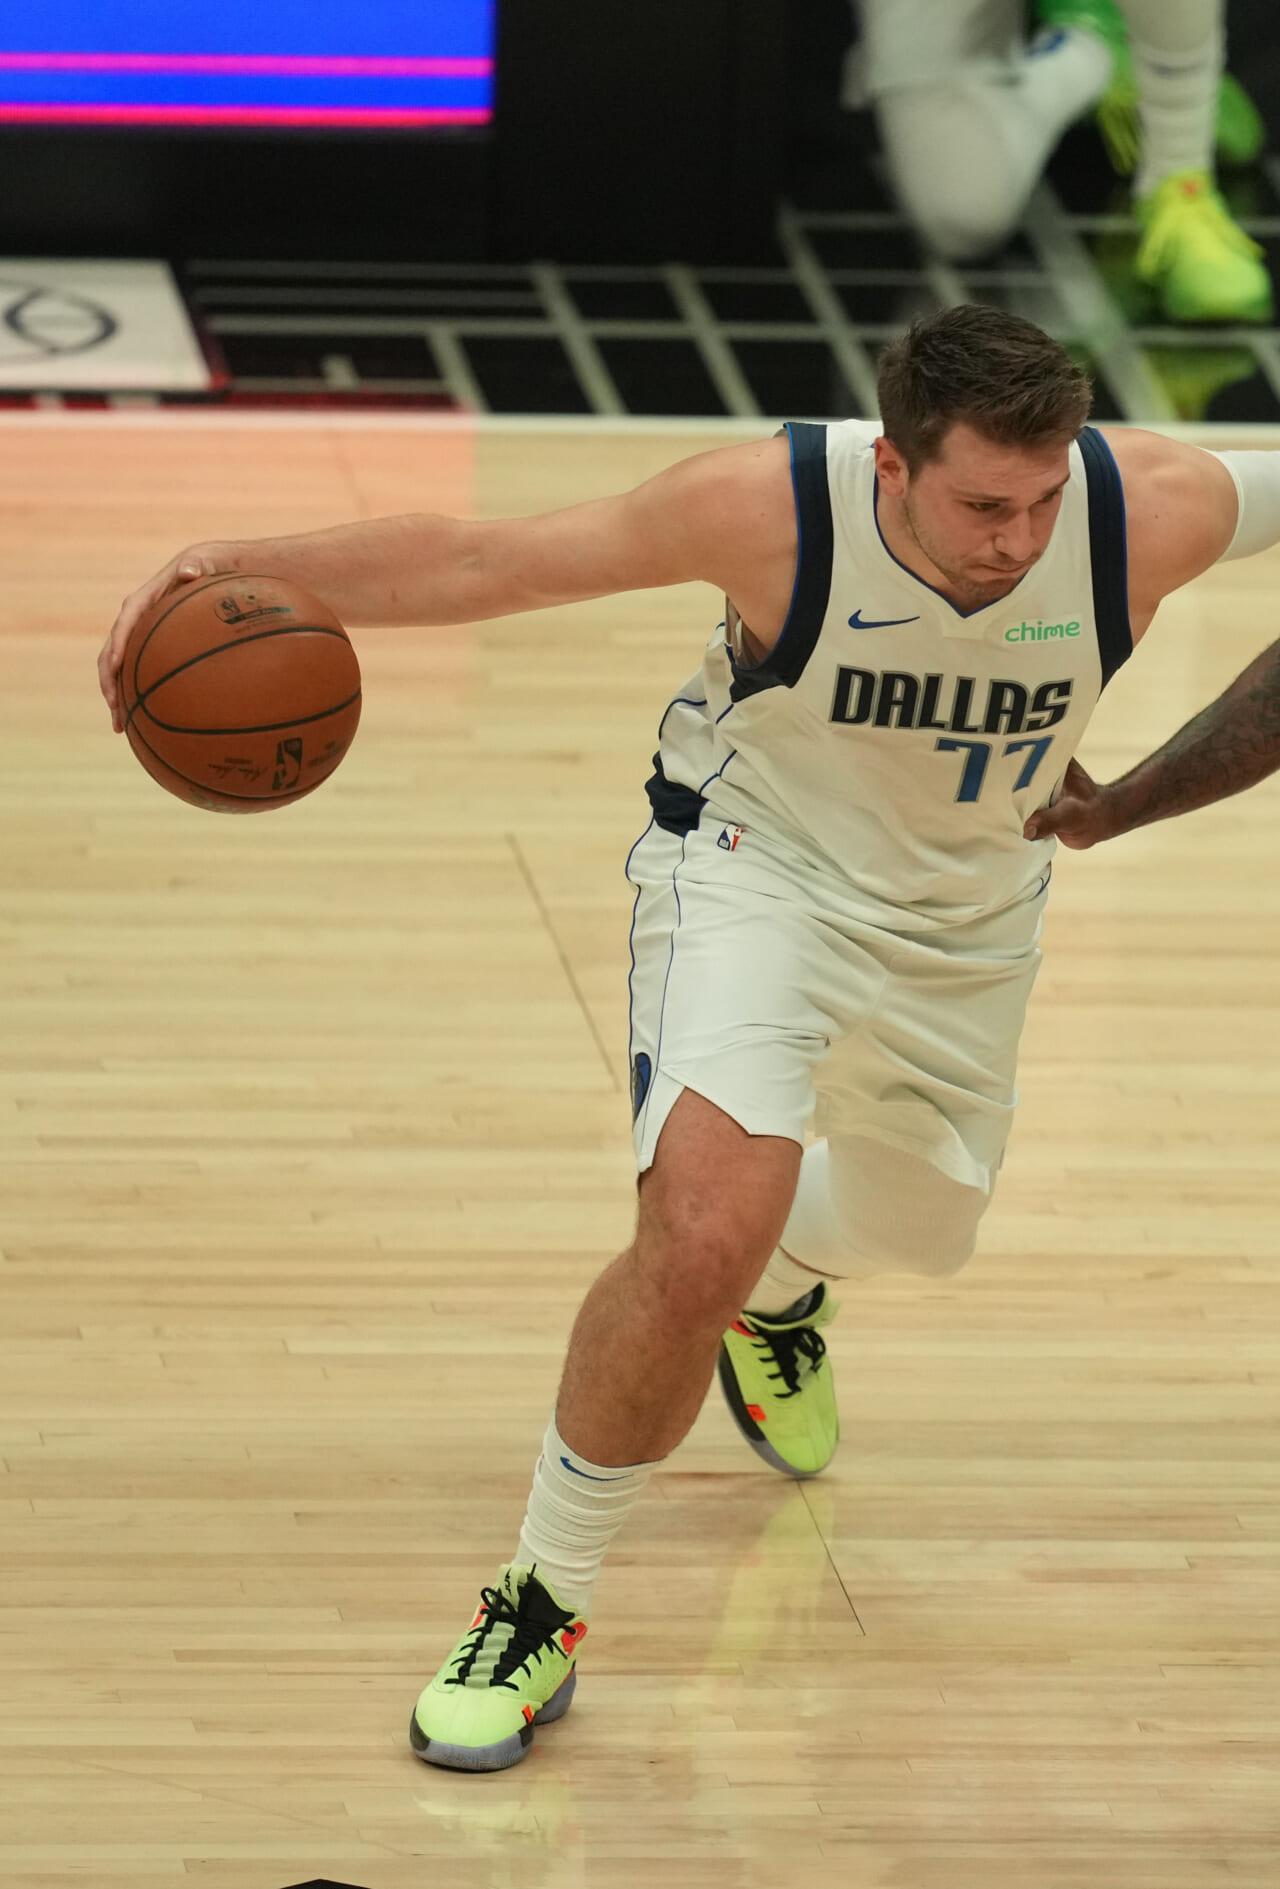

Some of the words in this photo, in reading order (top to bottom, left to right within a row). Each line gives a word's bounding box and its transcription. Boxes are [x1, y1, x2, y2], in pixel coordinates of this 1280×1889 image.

[1004, 620, 1080, 642] chime
[828, 664, 1074, 735] DALLAS
[934, 735, 1055, 803] 77
